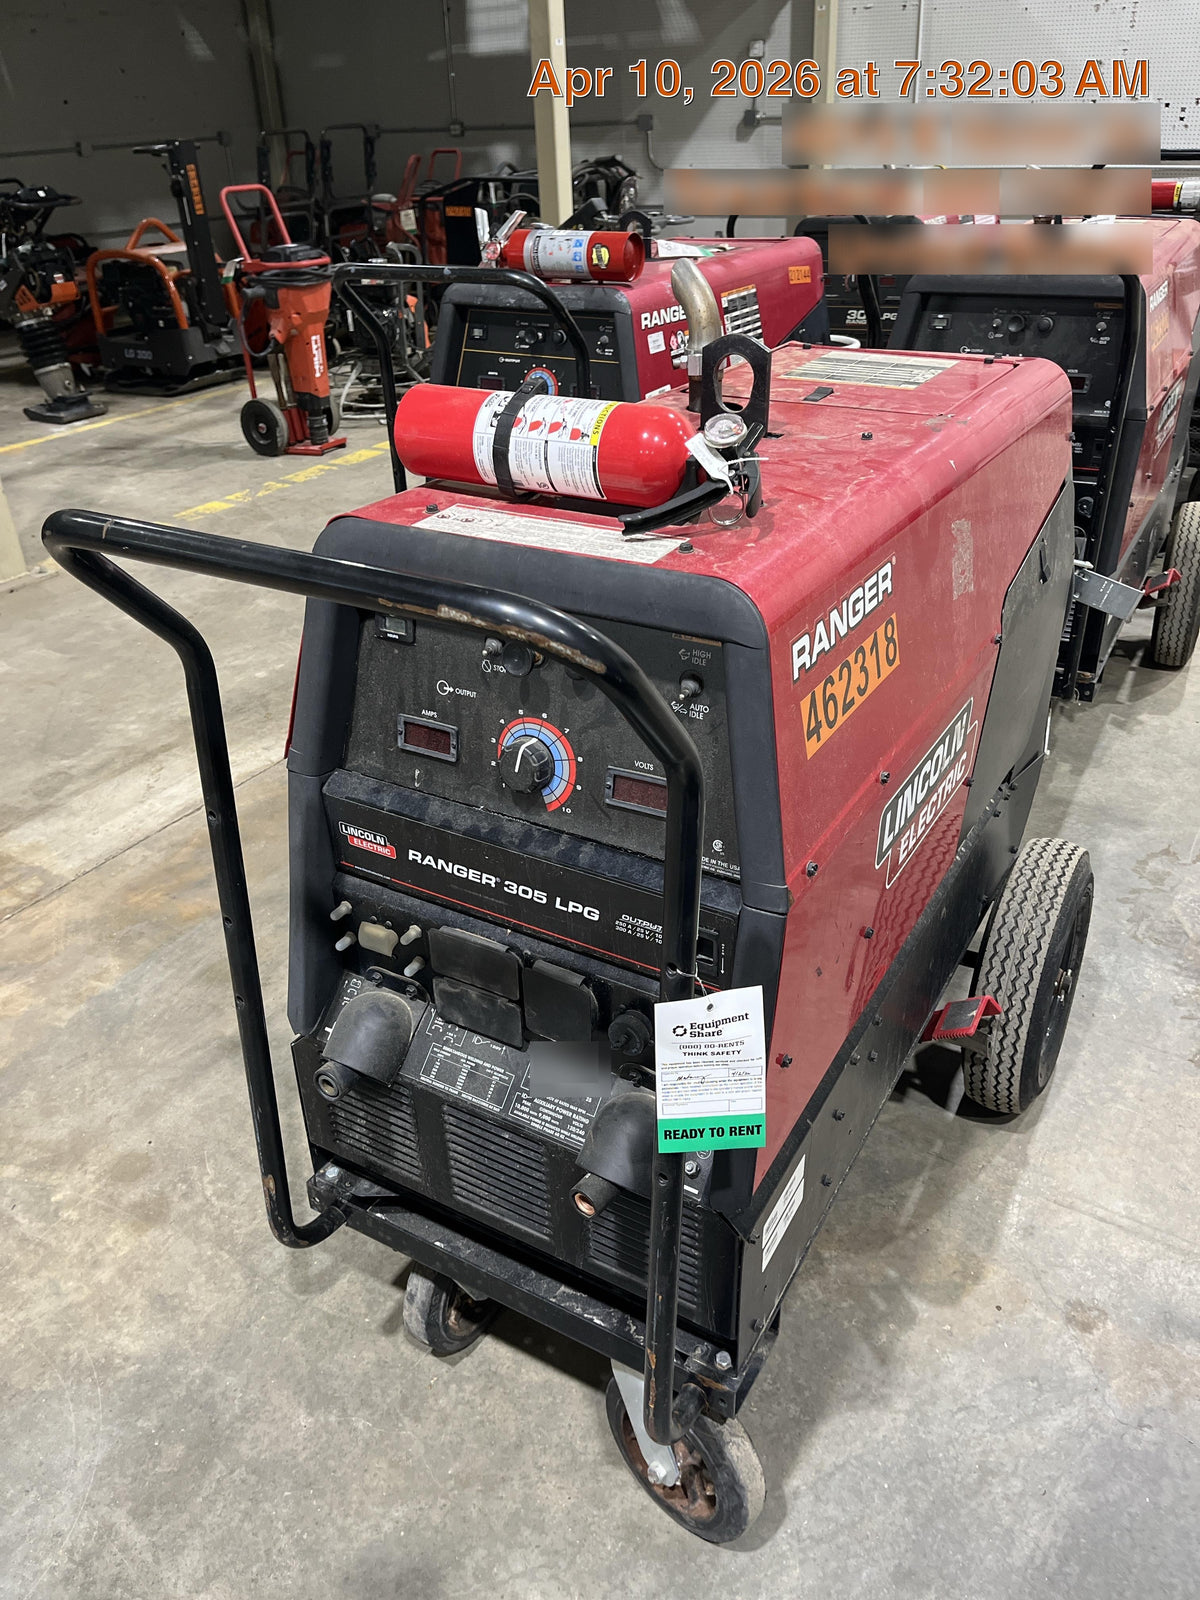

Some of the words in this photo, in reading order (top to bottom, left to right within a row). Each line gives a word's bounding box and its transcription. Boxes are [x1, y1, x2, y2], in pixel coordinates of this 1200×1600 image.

[641, 305, 688, 330] RANGE
[846, 310, 867, 320] 30
[792, 560, 894, 684] RANGER
[692, 649, 711, 660] HIGH
[691, 657, 706, 666] IDLE
[806, 616, 898, 743] 462318
[455, 688, 477, 698] OUTPUT
[421, 709, 438, 718] AMPS
[690, 703, 709, 714] AUTO
[689, 711, 704, 720] IDLE
[634, 760, 654, 771] VOLTS
[883, 711, 969, 852] LINCOLN
[562, 806, 572, 814] 10
[898, 751, 968, 866] ELECTRIC
[342, 825, 385, 846] LINCOLN
[353, 838, 391, 856] ELECTRIC
[717, 860, 729, 868] THE
[503, 880, 548, 905] 305
[555, 896, 600, 921] LPG
[621, 914, 663, 931] OUTPUT
[689, 1012, 750, 1031] Equipment
[689, 1029, 723, 1038] Share
[710, 1049, 742, 1057] SAFETY
[491, 1065, 505, 1073] POWER
[533, 1098, 556, 1110] AUXILIARY
[556, 1106, 572, 1118] POWER
[572, 1113, 589, 1124] RATING
[664, 1127, 706, 1140] READY
[709, 1126, 725, 1138] TO
[728, 1124, 763, 1137] RENT
